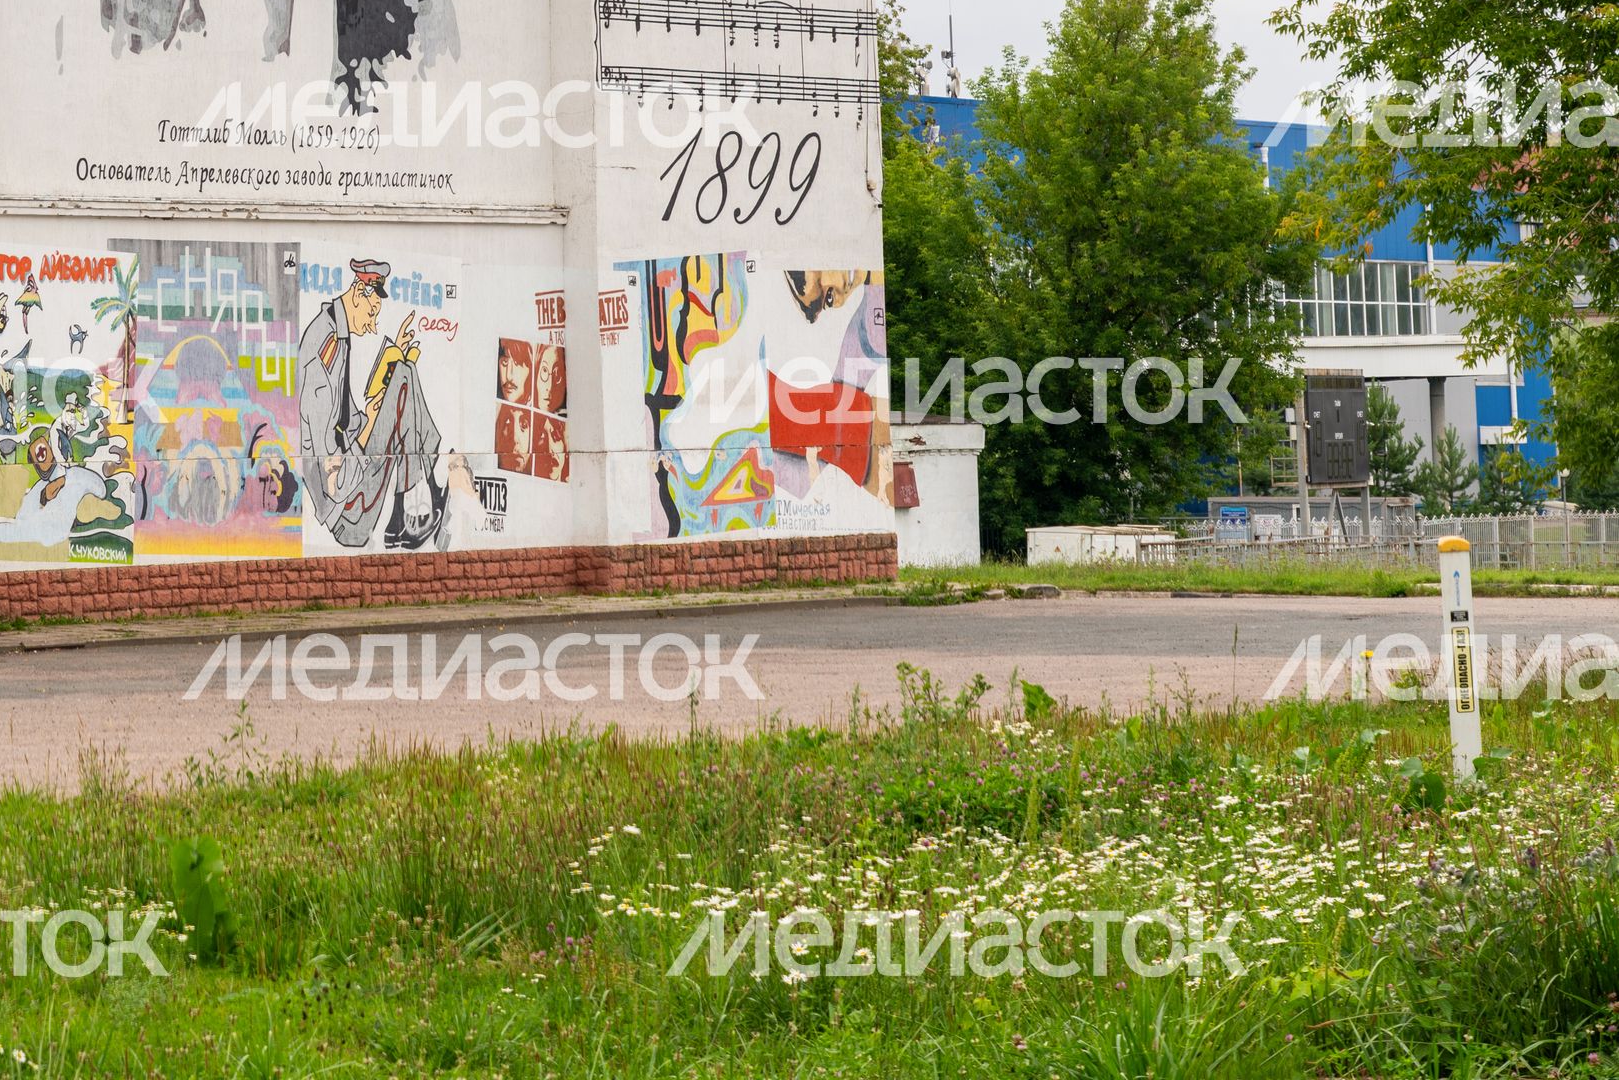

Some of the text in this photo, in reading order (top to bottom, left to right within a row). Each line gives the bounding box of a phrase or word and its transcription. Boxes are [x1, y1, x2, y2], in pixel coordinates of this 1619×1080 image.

[291, 124, 380, 155] (1859-1926)
[76, 158, 456, 196] Основатель Апрелевского завода грампластинок
[659, 127, 821, 225] 1899
[535, 297, 556, 324] THE
